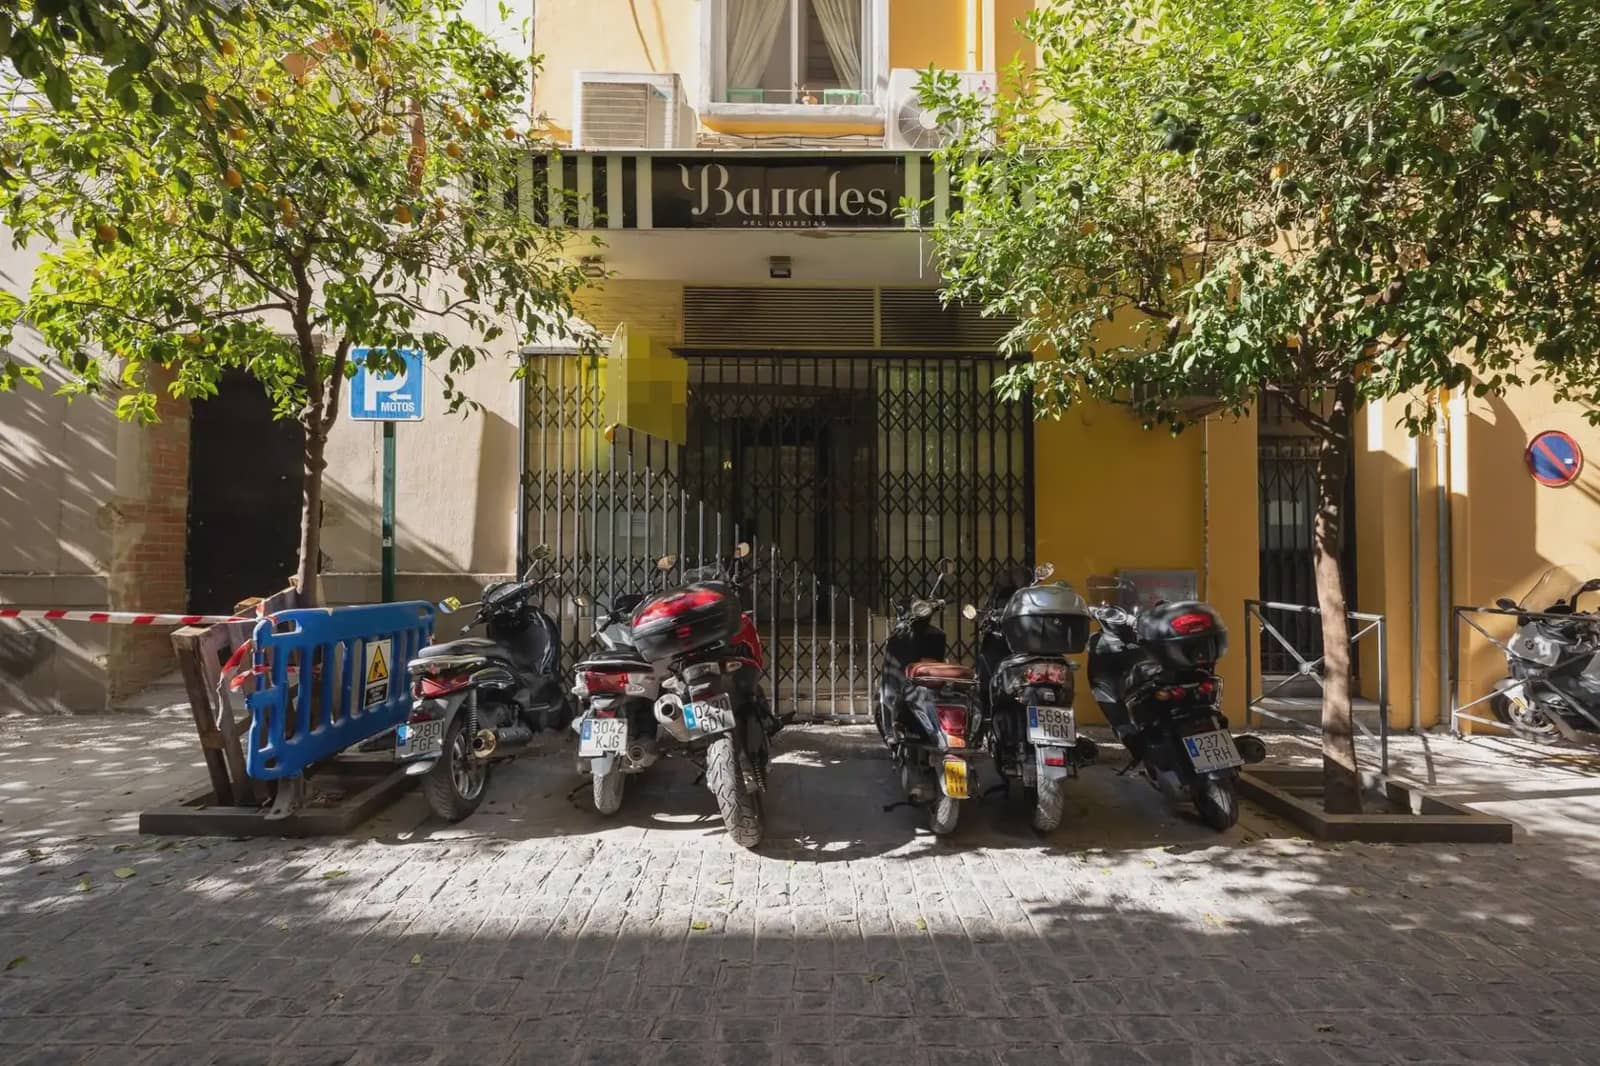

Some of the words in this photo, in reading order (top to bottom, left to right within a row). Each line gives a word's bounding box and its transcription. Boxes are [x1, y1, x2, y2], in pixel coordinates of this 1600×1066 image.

[677, 163, 889, 217] Barrales
[364, 353, 408, 411] P
[381, 401, 415, 412] MOTOS
[593, 720, 624, 735] 3042
[1043, 723, 1070, 738] HGN
[595, 735, 620, 749] KJG
